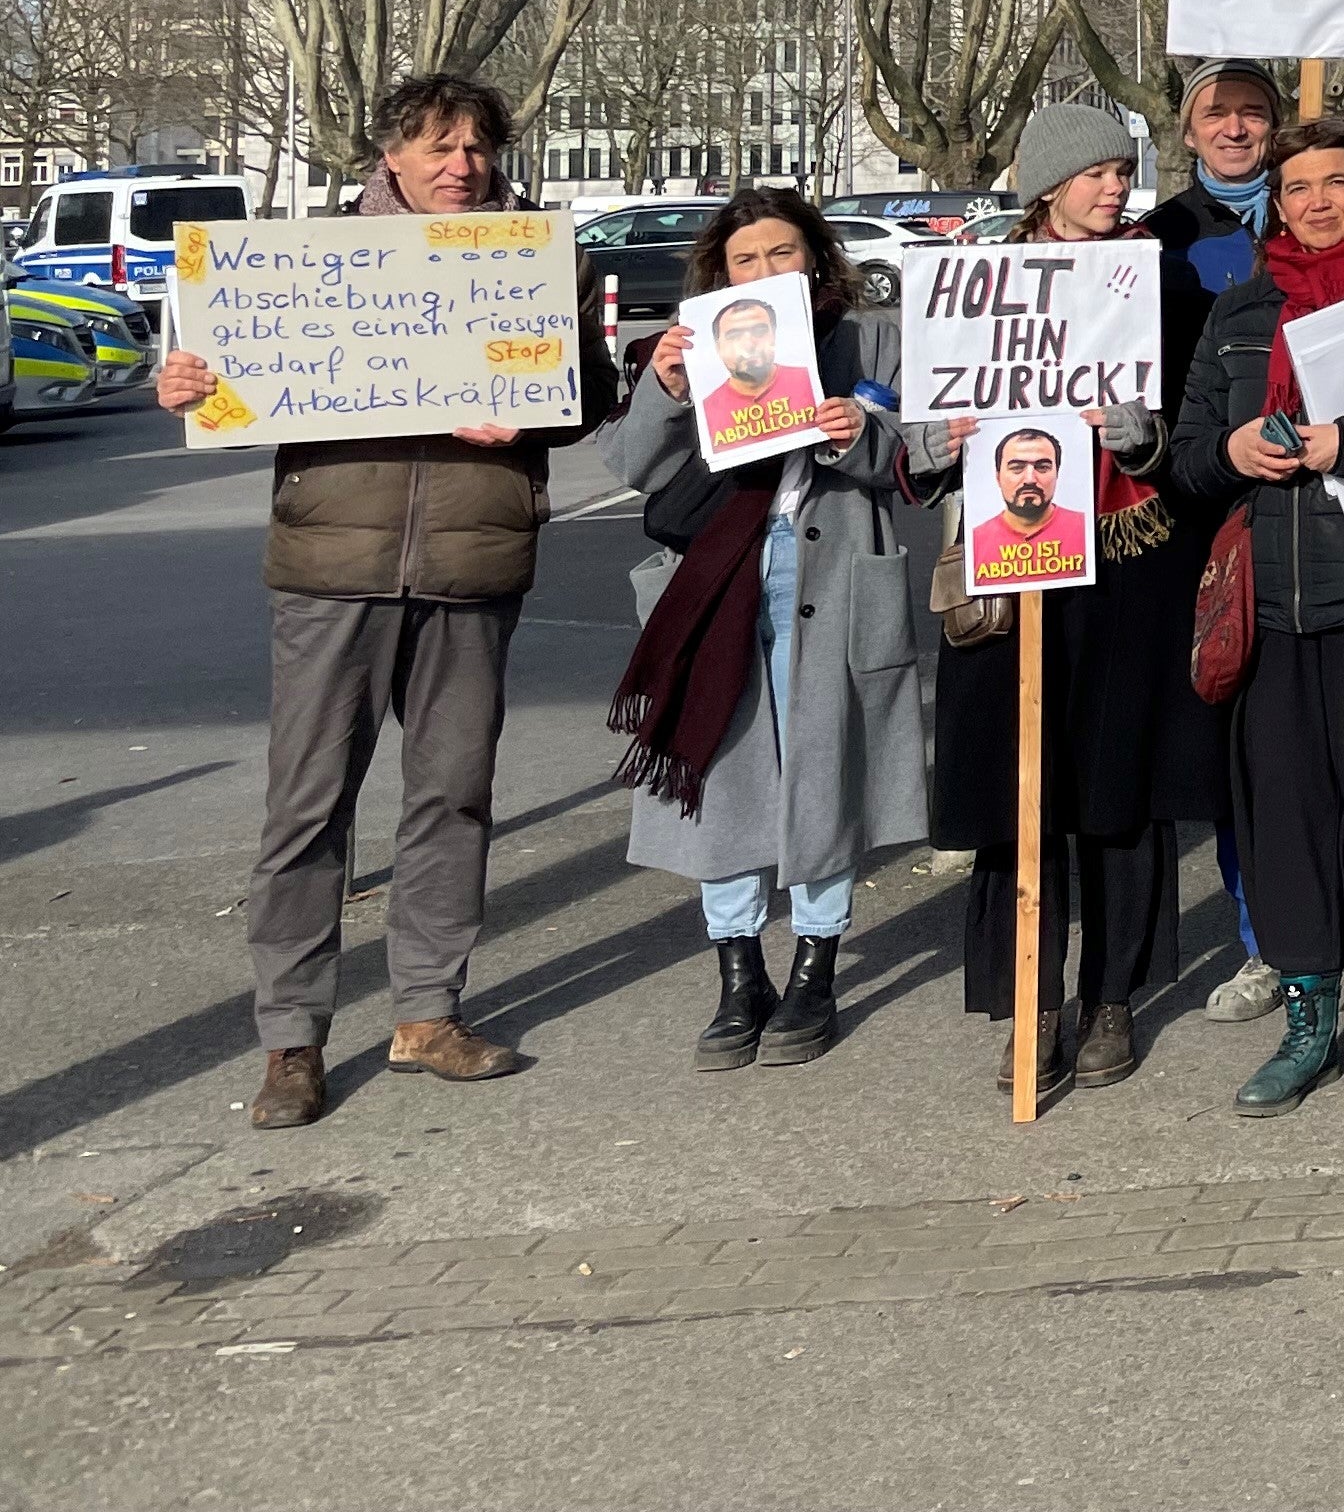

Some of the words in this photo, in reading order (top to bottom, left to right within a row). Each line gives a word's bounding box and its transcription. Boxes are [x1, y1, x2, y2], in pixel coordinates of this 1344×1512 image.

[428, 220, 489, 249] Stop
[208, 237, 397, 286] Weniger
[208, 282, 456, 322] Abschiebung,
[470, 278, 547, 303] hier
[925, 256, 1076, 319] HOLT
[212, 315, 290, 347] gibt
[302, 321, 335, 338] es
[352, 317, 448, 338] einen
[465, 312, 574, 338] riesigen
[991, 318, 1068, 362] IHN
[219, 345, 345, 385] Bedarf
[367, 355, 409, 371] an
[487, 338, 563, 365] Stop!
[713, 406, 816, 448] ABDULLOH?
[731, 404, 764, 425] WO
[767, 397, 790, 415] IST
[976, 554, 1084, 580] ABDULLOH?
[999, 543, 1033, 561] WO
[1036, 539, 1061, 559] IST
